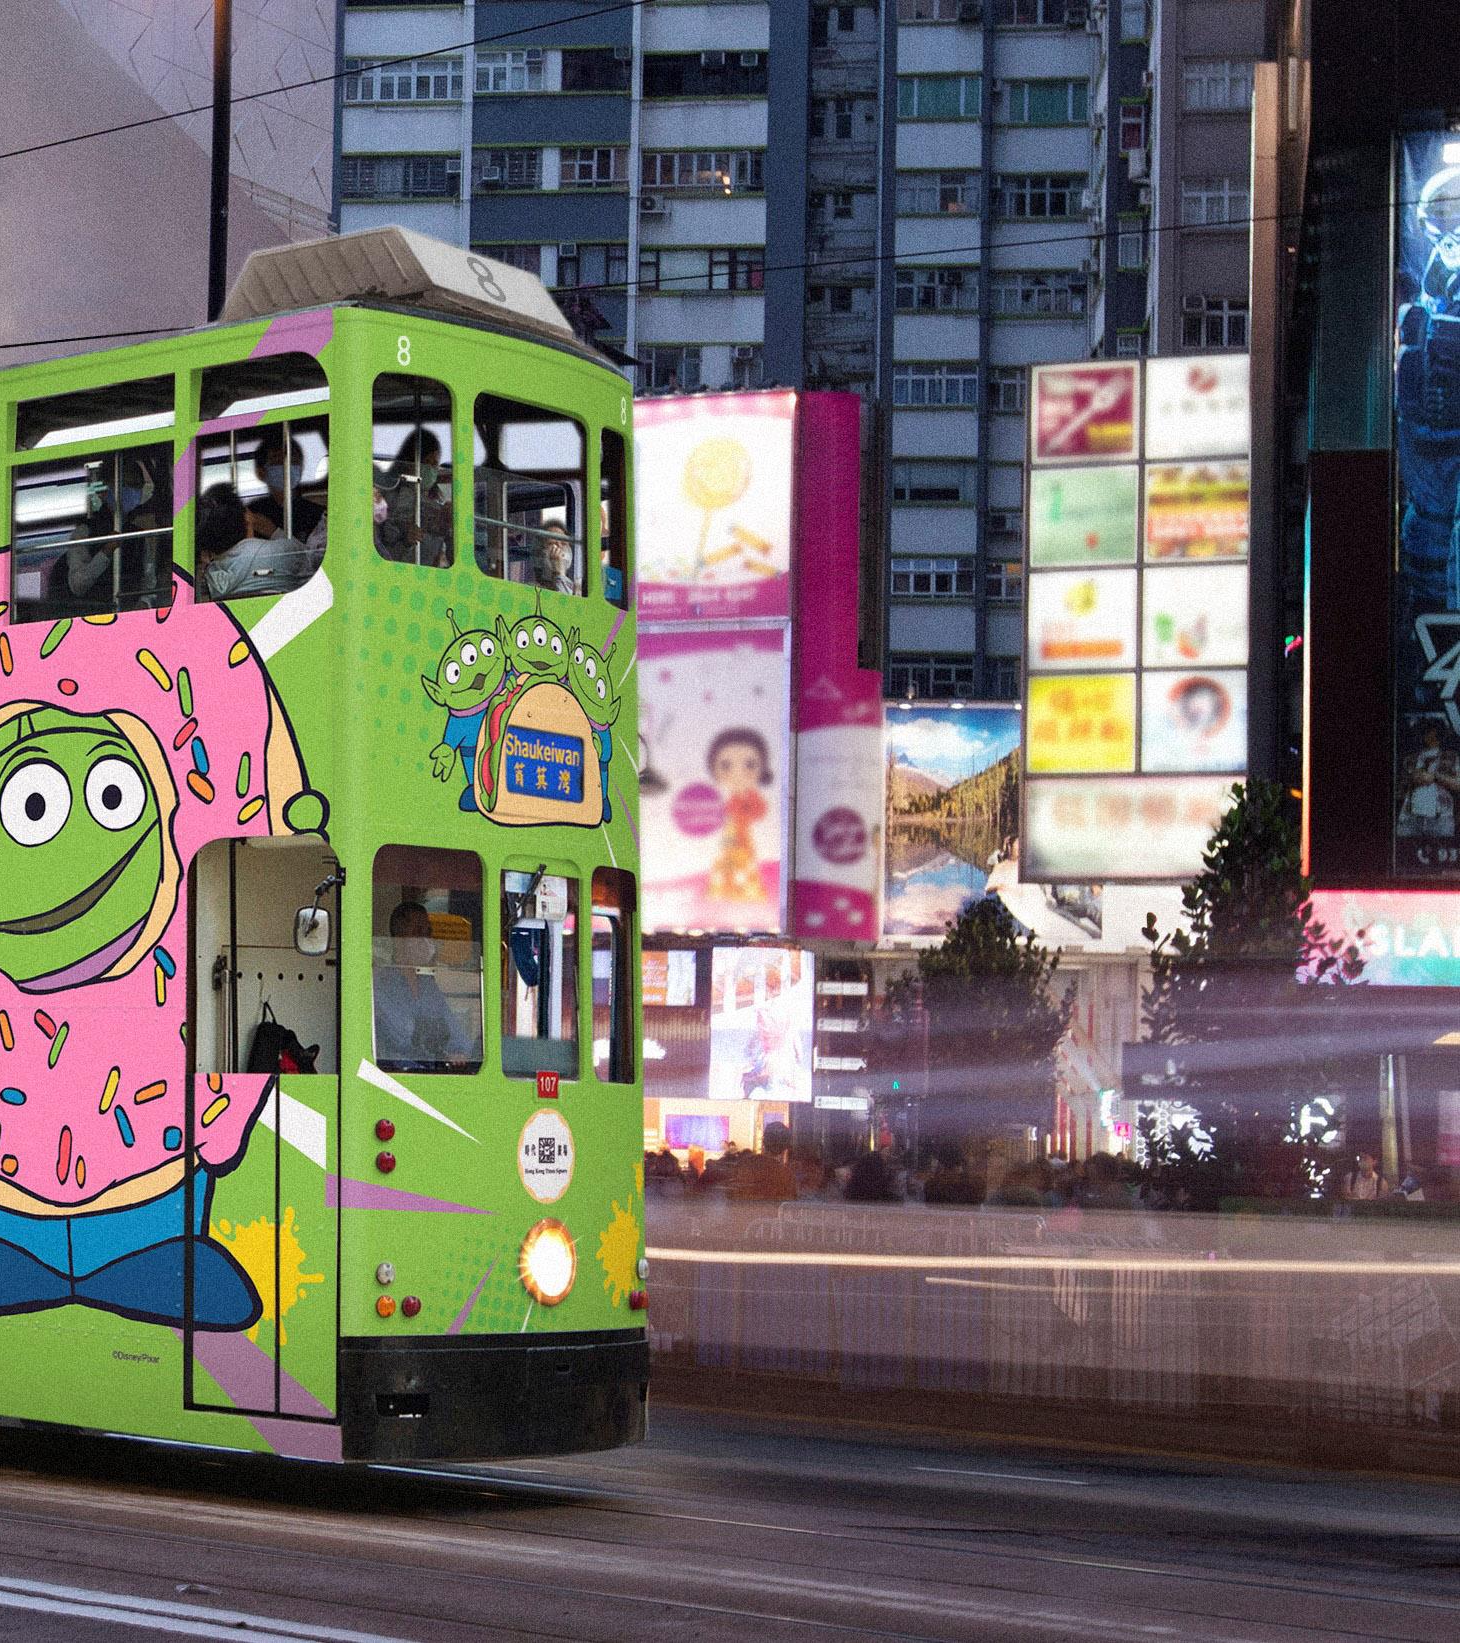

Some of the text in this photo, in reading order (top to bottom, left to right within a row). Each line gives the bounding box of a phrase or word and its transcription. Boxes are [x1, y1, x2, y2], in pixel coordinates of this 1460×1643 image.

[467, 256, 506, 302] 8
[397, 336, 411, 366] 8
[620, 397, 627, 425] 8
[505, 733, 581, 766] Shaukeiwan
[540, 1076, 557, 1092] 107
